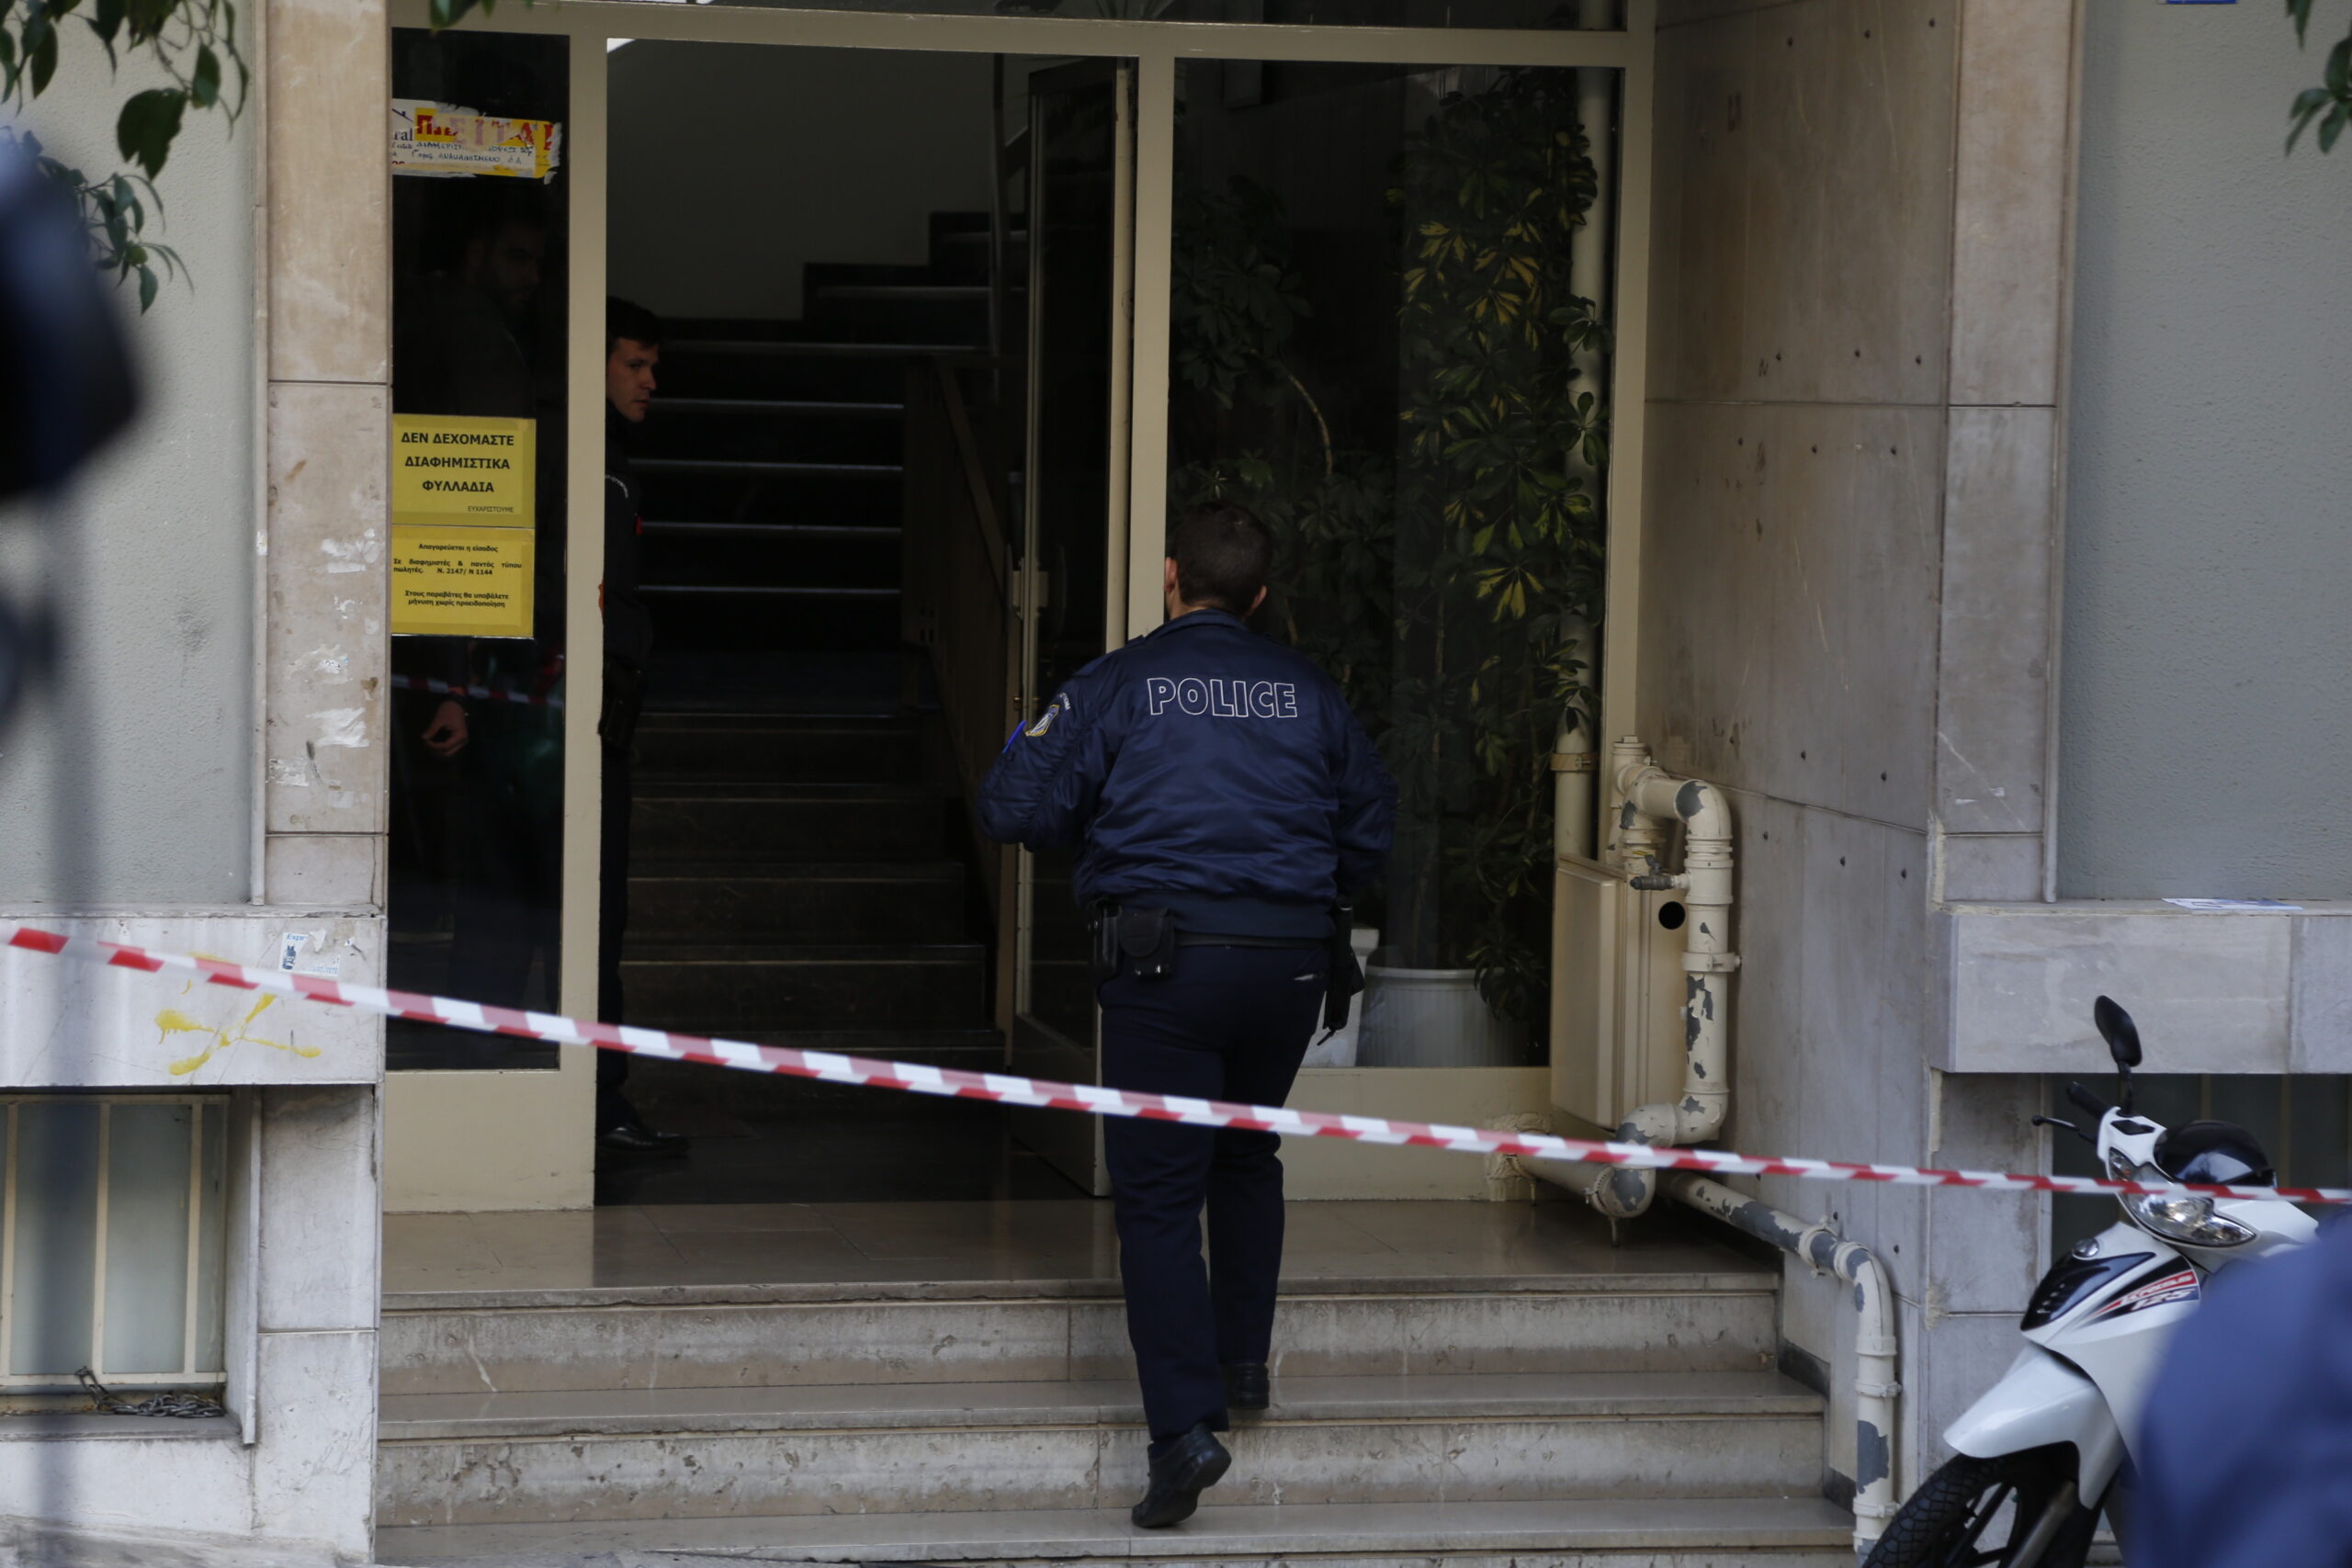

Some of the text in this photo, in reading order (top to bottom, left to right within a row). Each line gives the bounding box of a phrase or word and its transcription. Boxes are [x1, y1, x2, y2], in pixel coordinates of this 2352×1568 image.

[401, 433, 514, 446] ΔΕΝ ΔΕΧΟΜΑΣΤΕ
[405, 457, 511, 469] ΔΙΑΦΗΜΙΣΤΙΚΑ
[423, 480, 494, 492] ΦΥΛΛΑΔΙΑ
[468, 505, 514, 513] ΕΥΧΑΡΙΣΤΟΥΜΕ
[419, 544, 465, 553] Απαγορεύεται
[472, 545, 499, 553] είσοδος
[409, 558, 451, 568] διαφημιστές
[405, 590, 425, 598] Στους
[426, 591, 462, 599] παραβάτες
[435, 599, 455, 607] χωρίς
[457, 600, 505, 608] προειδοποίηση
[1148, 677, 1298, 718] POLICE
[287, 933, 308, 942] Expr
